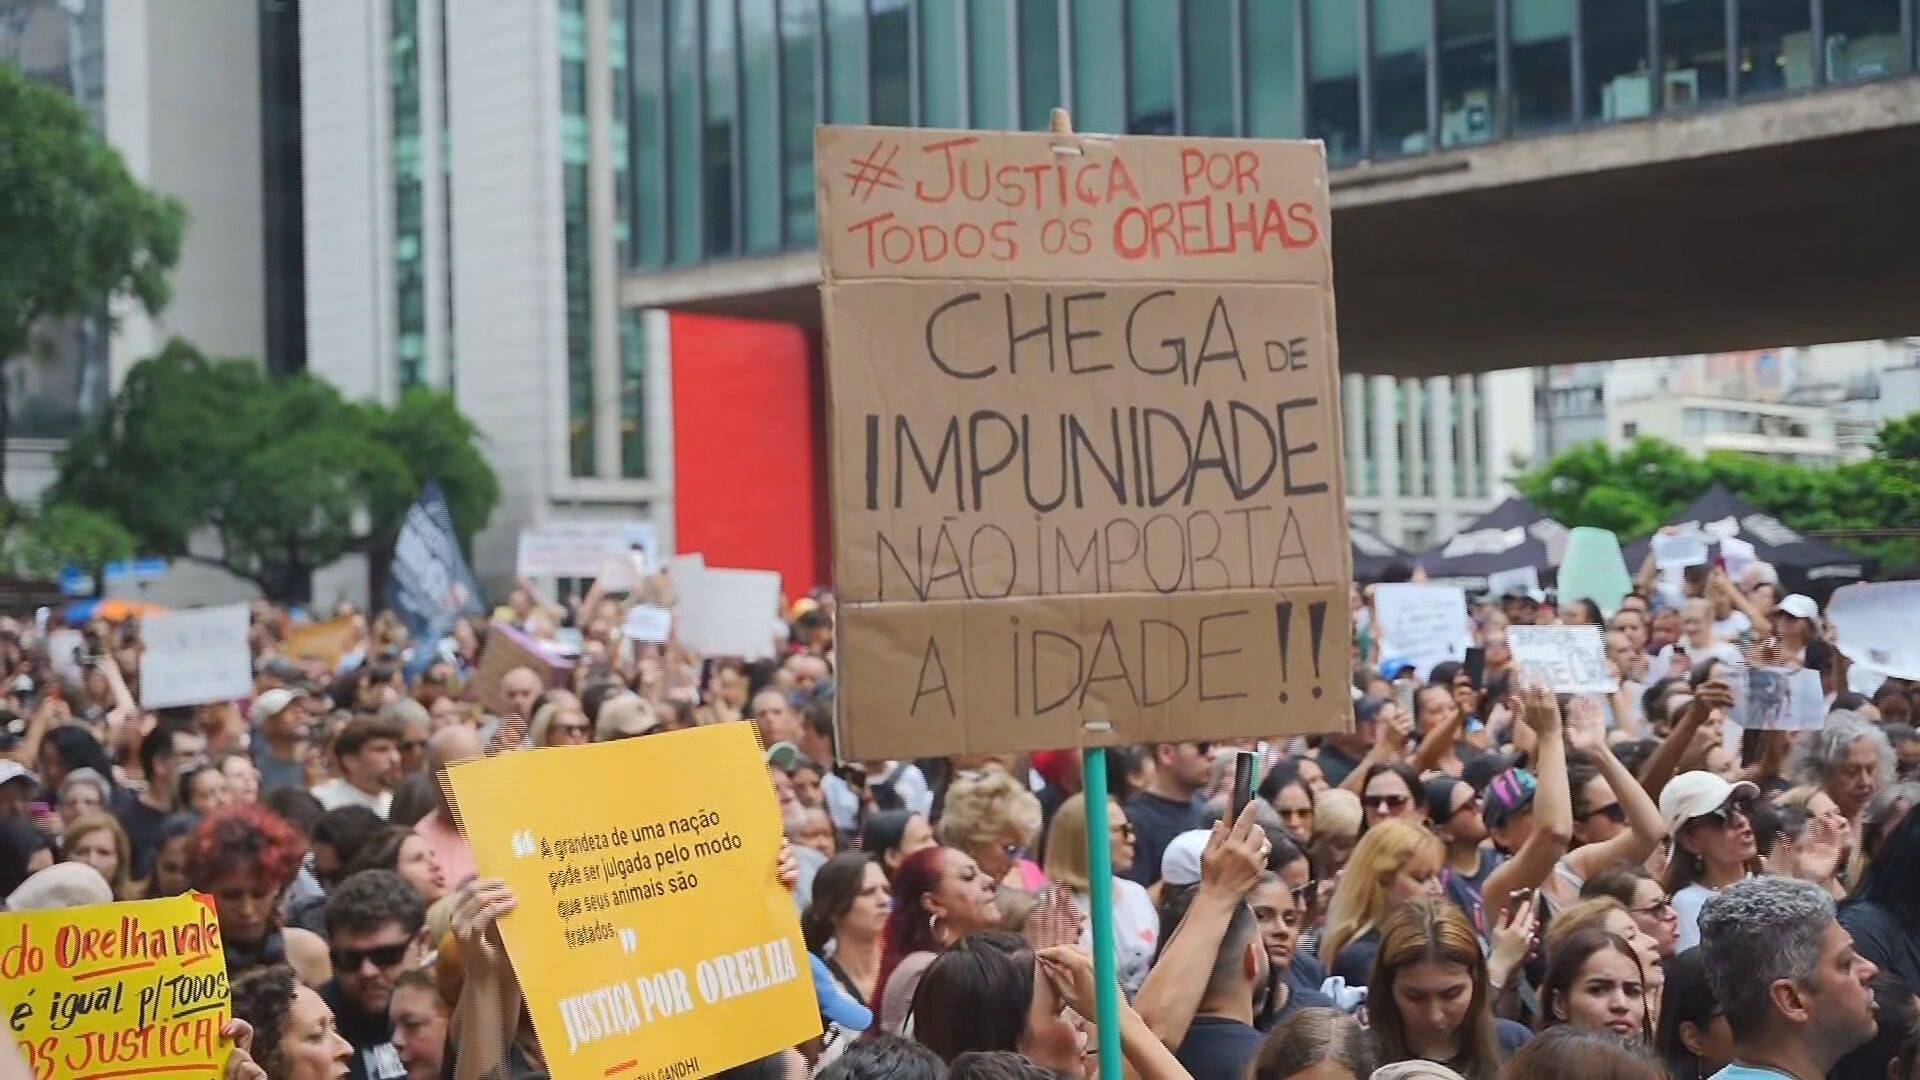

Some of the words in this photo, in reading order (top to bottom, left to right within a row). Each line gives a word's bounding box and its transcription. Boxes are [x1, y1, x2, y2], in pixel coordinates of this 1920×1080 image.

[1180, 147, 1260, 195] POR
[848, 211, 1019, 268] TODOS
[1041, 218, 1092, 254] OS
[1113, 195, 1319, 258] ORELHAS
[926, 290, 1247, 386] CHEGA
[1265, 338, 1307, 373] DE
[866, 398, 1328, 513] IMPUNIDADE
[877, 516, 1018, 602] NÃO
[911, 636, 956, 717] A
[548, 865, 582, 895] pode
[583, 864, 601, 881] ser
[603, 852, 652, 884] julgada
[655, 843, 690, 872] pelo
[694, 832, 742, 858] modo
[554, 830, 609, 861] grandeza
[611, 827, 628, 846] de
[631, 822, 665, 842] uma
[669, 809, 720, 836] nação
[557, 898, 582, 922] que
[583, 893, 610, 914] seus
[612, 878, 665, 906] animais
[669, 870, 698, 894] são
[172, 907, 219, 956] vale
[10, 988, 35, 1031] é
[49, 981, 123, 1031] igual
[558, 981, 641, 1055] JUSTIÇA
[636, 968, 694, 1023] POR
[696, 937, 798, 1005] ORELHA
[657, 1056, 700, 1080] GANDHI
